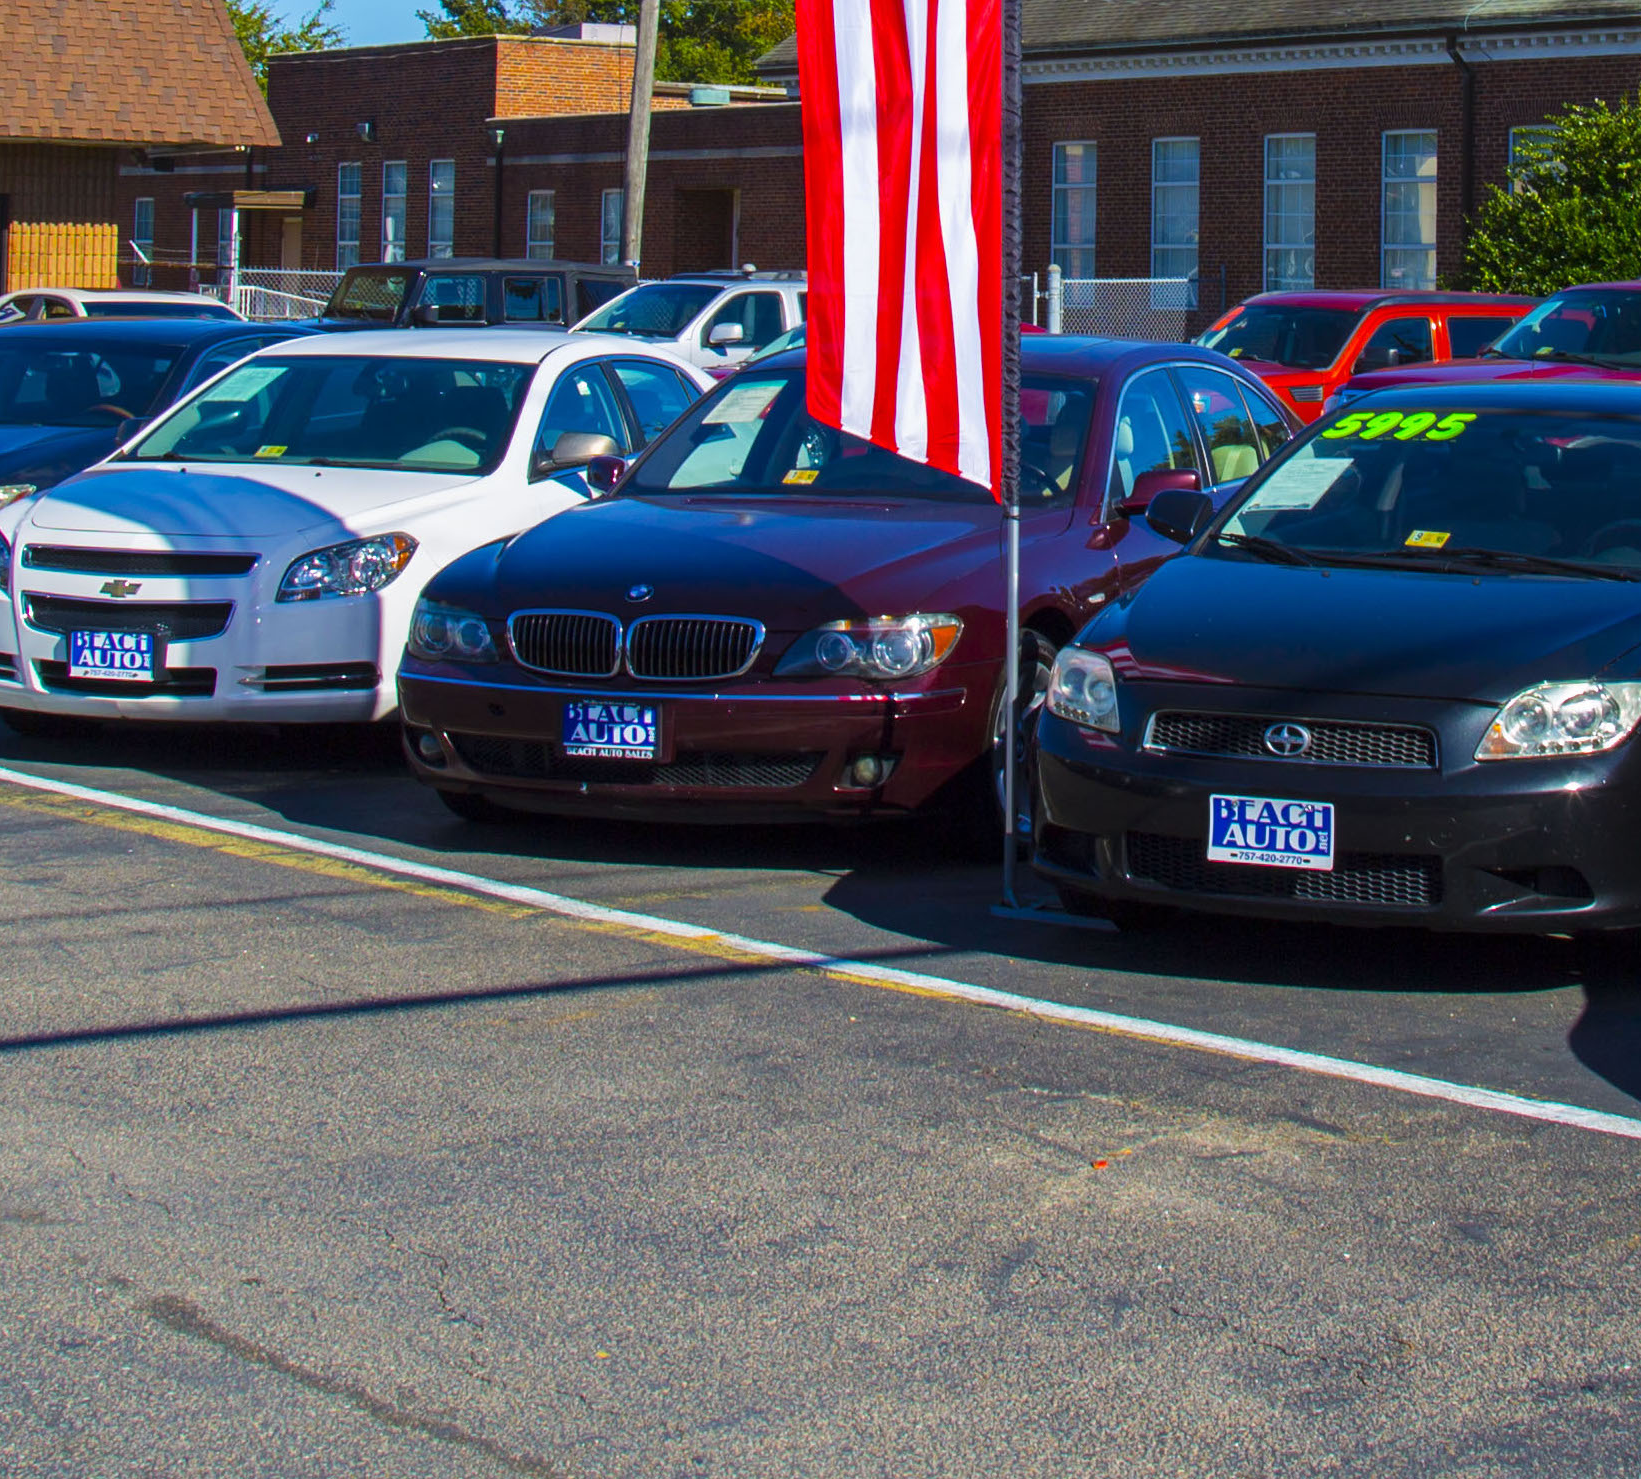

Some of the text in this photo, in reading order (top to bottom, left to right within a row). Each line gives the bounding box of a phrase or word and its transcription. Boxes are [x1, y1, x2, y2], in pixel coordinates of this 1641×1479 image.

[1322, 411, 1477, 440] 5995
[73, 631, 152, 651] BEACH
[78, 649, 143, 669] AUTO
[571, 723, 647, 745] AUTO
[598, 748, 622, 758] AUTO
[624, 750, 653, 759] SALES
[1214, 798, 1330, 828] BEACH
[1222, 822, 1316, 852] AUTO
[1239, 852, 1303, 864] 757-420-2770
